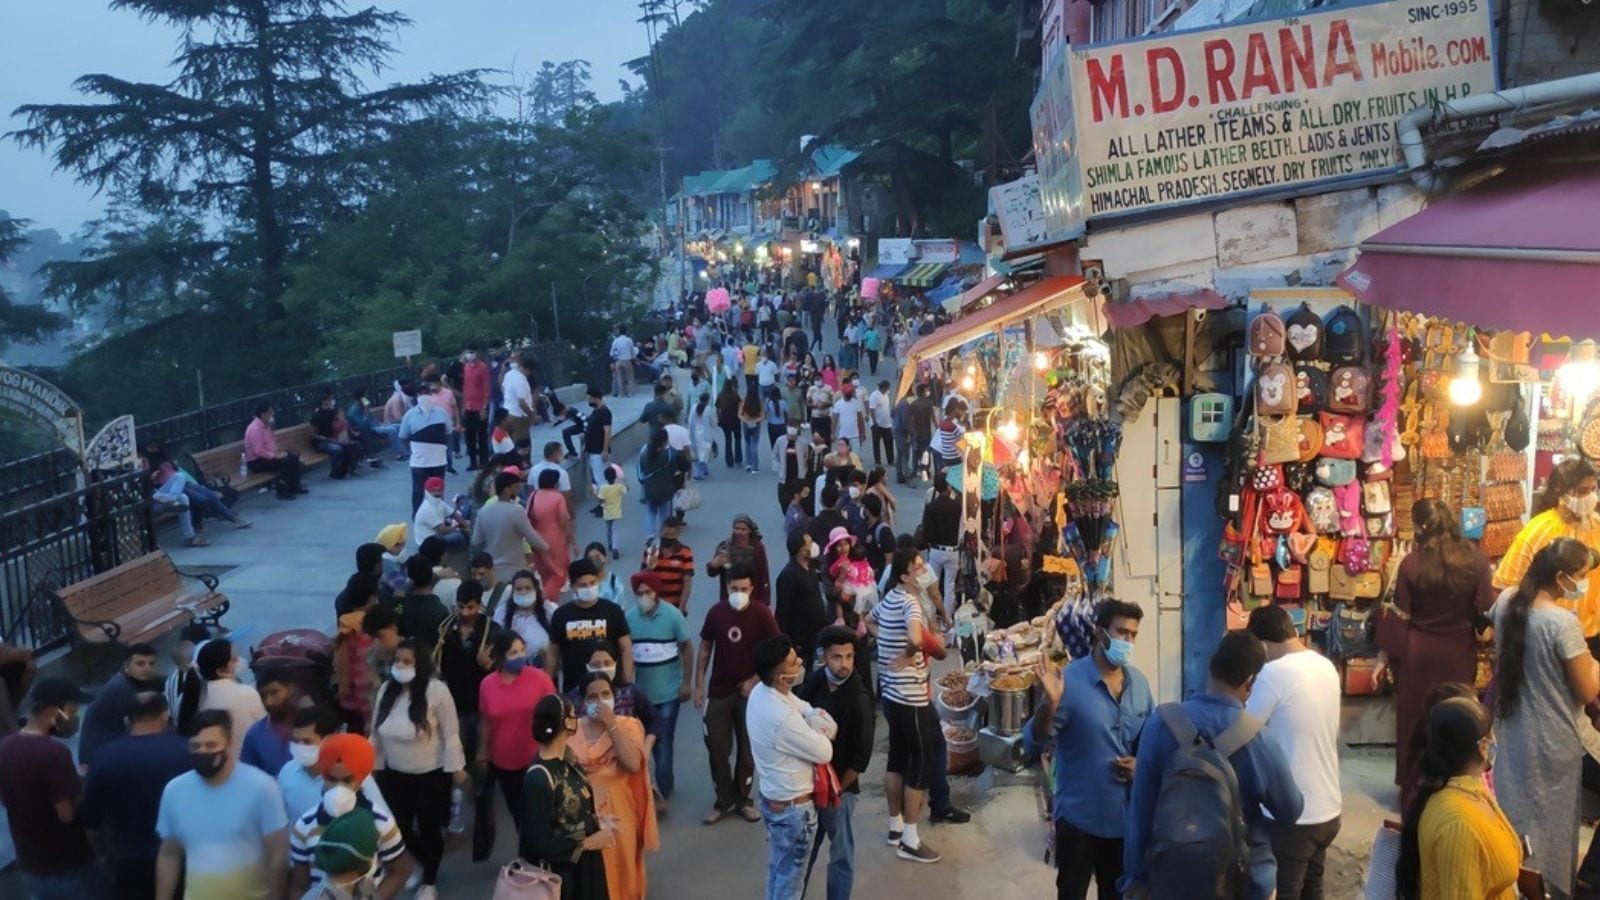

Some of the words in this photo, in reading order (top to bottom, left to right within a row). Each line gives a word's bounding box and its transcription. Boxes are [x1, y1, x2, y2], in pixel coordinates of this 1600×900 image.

[1087, 160, 1133, 188] SHIMLA
[1137, 152, 1189, 178] FAMOUS
[1193, 143, 1247, 170] LATHER
[1299, 129, 1335, 154] LADIS
[1351, 122, 1391, 146] JENTS
[1090, 187, 1155, 213] HIMACHAL
[1283, 157, 1306, 183] DRY
[1311, 153, 1354, 178] FRUITS
